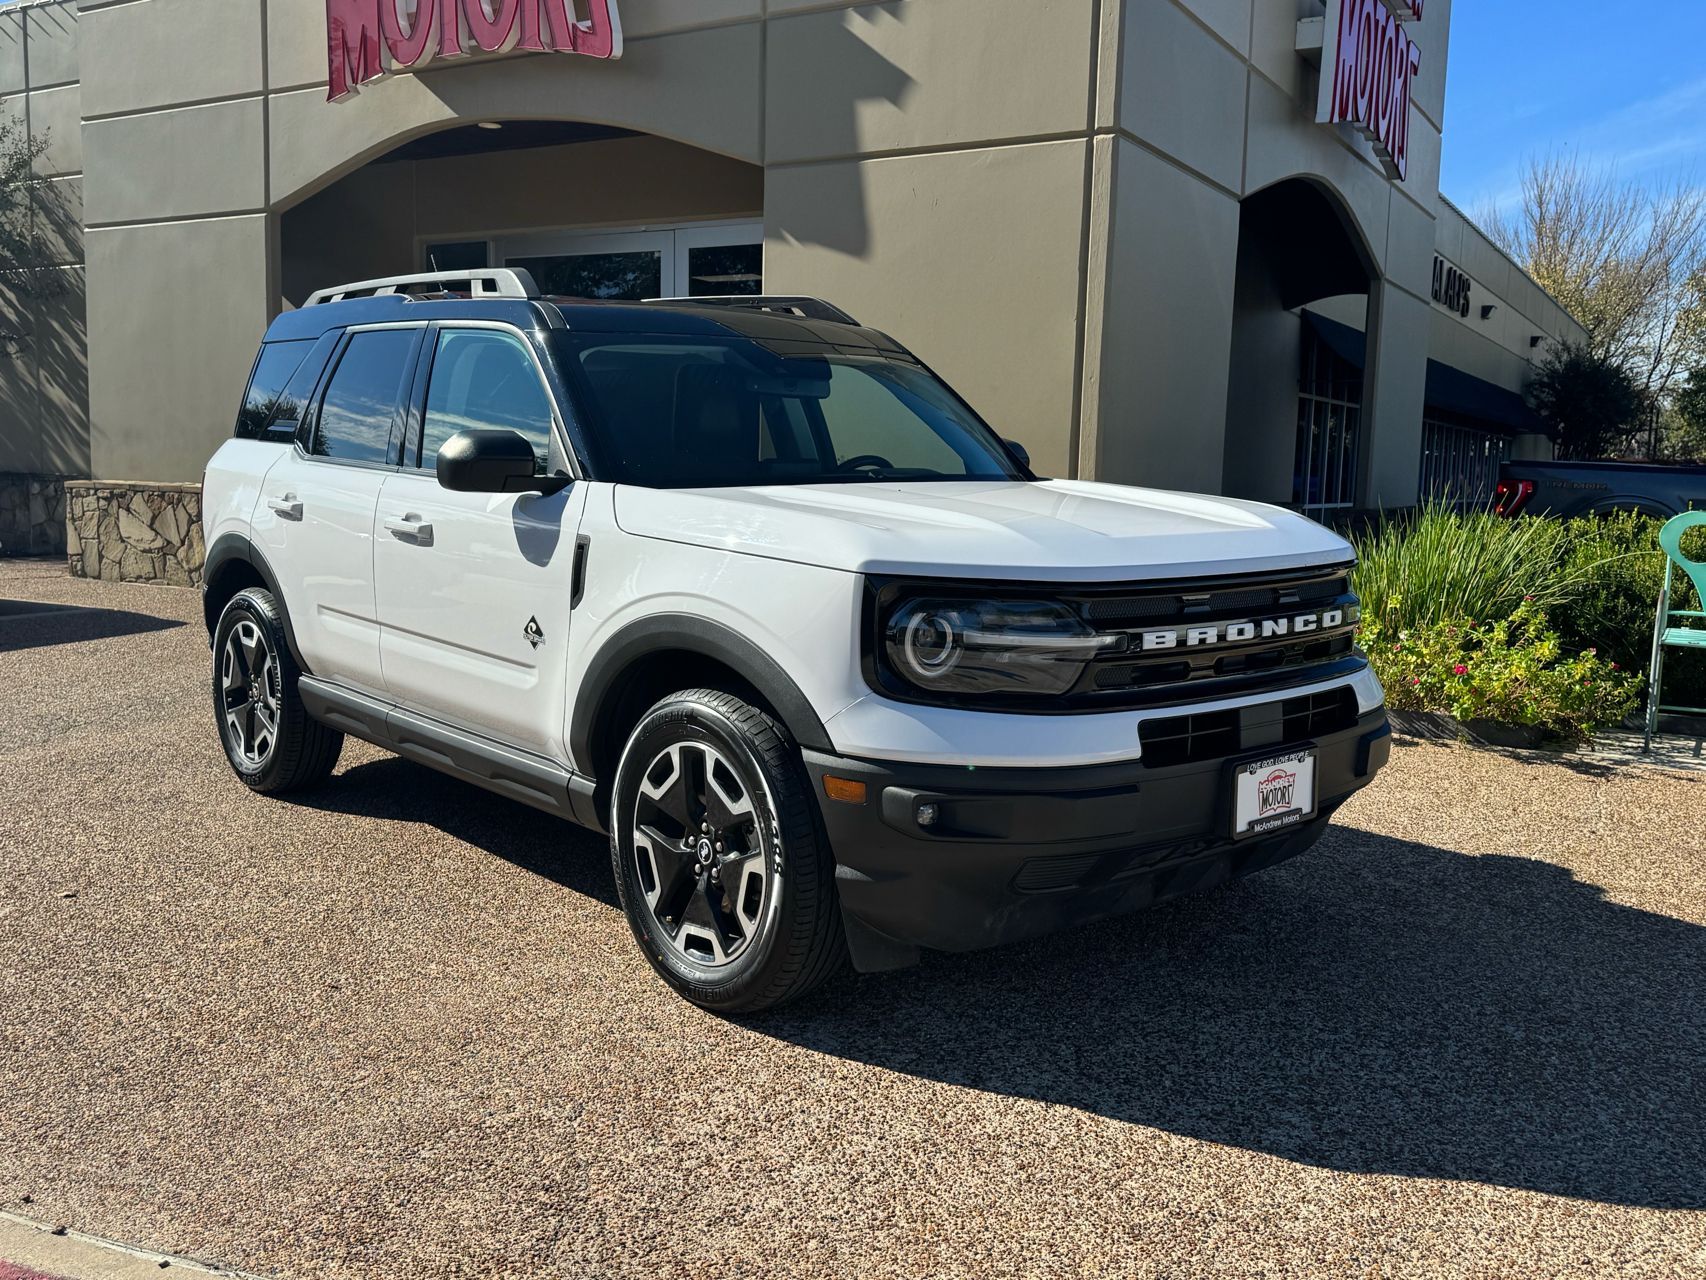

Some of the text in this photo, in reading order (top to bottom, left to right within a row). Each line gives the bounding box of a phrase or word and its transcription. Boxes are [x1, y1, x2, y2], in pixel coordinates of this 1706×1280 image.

[1141, 609, 1343, 650] BRONCO
[1260, 784, 1293, 812] MOTORS
[1254, 814, 1300, 833] McAndrew Motors
